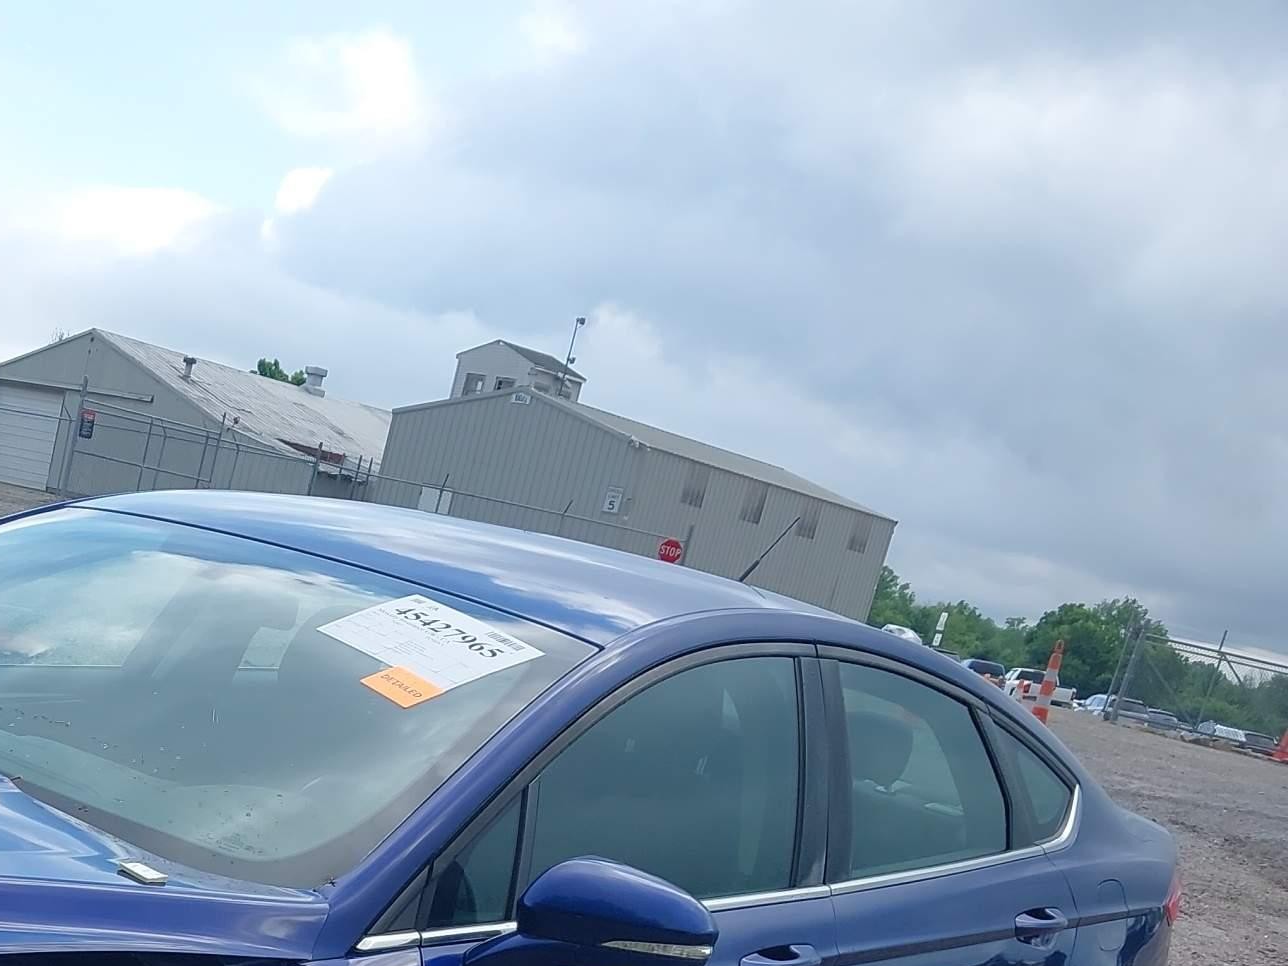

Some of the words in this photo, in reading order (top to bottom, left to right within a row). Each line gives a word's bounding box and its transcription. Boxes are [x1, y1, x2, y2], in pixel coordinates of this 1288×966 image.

[607, 500, 616, 511] 5
[659, 544, 682, 558] STOP
[395, 606, 505, 659] 45427965
[379, 673, 423, 699] DETAILED
